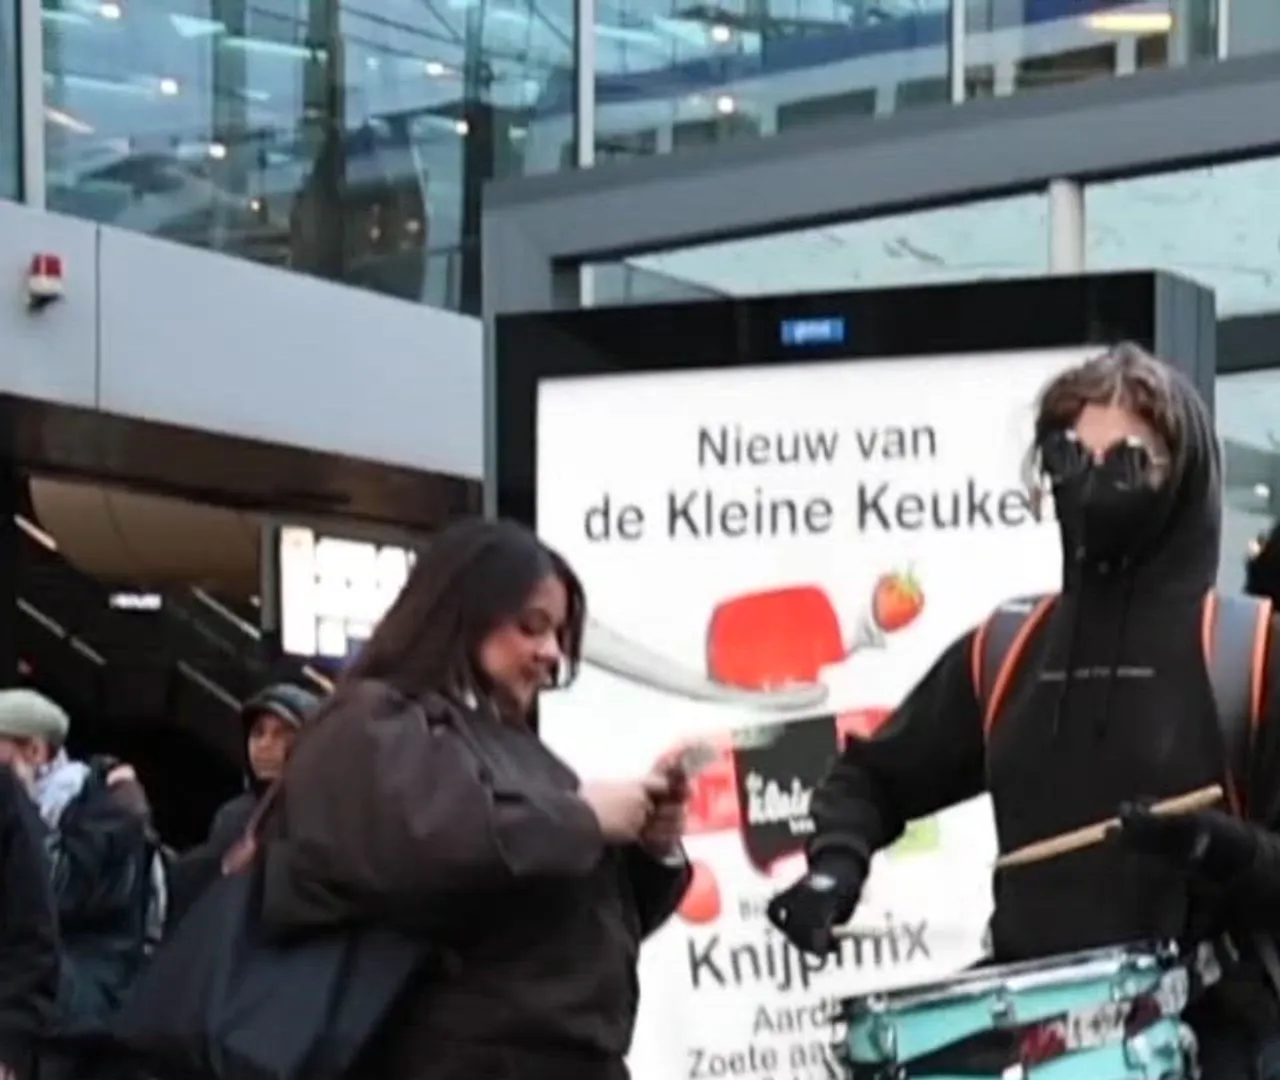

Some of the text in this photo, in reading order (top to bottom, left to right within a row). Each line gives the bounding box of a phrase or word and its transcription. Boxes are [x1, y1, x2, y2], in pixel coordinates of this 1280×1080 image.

[698, 423, 937, 467] Nieuw van
[584, 495, 645, 541] de
[666, 487, 834, 538] Kleine
[688, 1042, 779, 1080] Zoete
